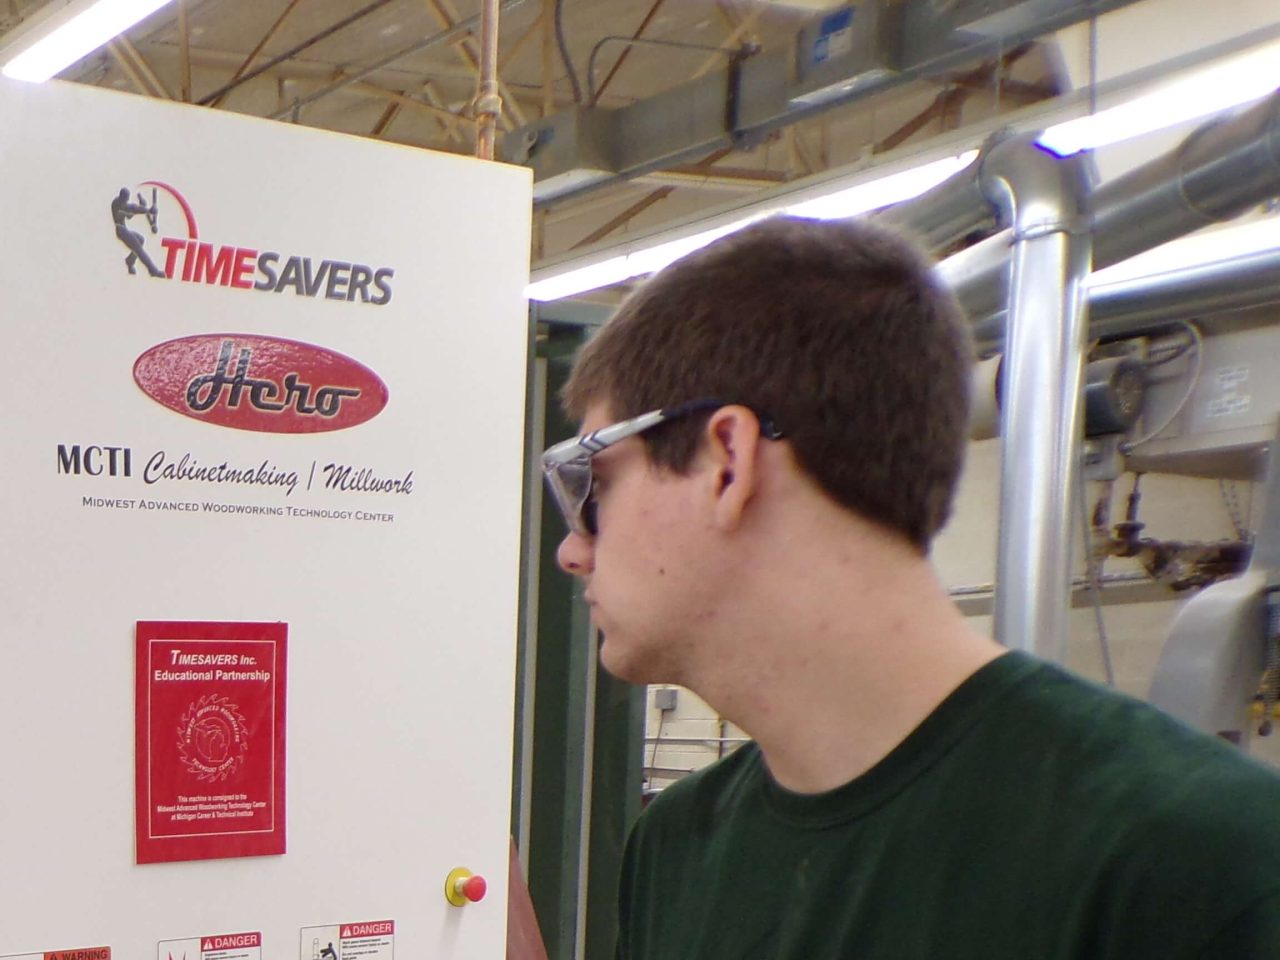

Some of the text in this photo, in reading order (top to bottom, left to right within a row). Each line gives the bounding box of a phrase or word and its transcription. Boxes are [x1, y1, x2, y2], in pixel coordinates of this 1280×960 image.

[161, 237, 395, 306] TIMESAVERS
[186, 339, 361, 418] Hero
[57, 444, 132, 477] MCTI
[143, 451, 299, 497] Cabinetmaking
[323, 462, 414, 495] Millwork
[82, 496, 395, 523] MIDWEST ADVANCED WOODWORKING TECHNOLOGY CENTER
[170, 650, 257, 665] TIMESAVERS Inc.
[154, 669, 271, 683] Educational Partnership
[352, 922, 392, 936] DANGER
[214, 934, 258, 949] DANGER
